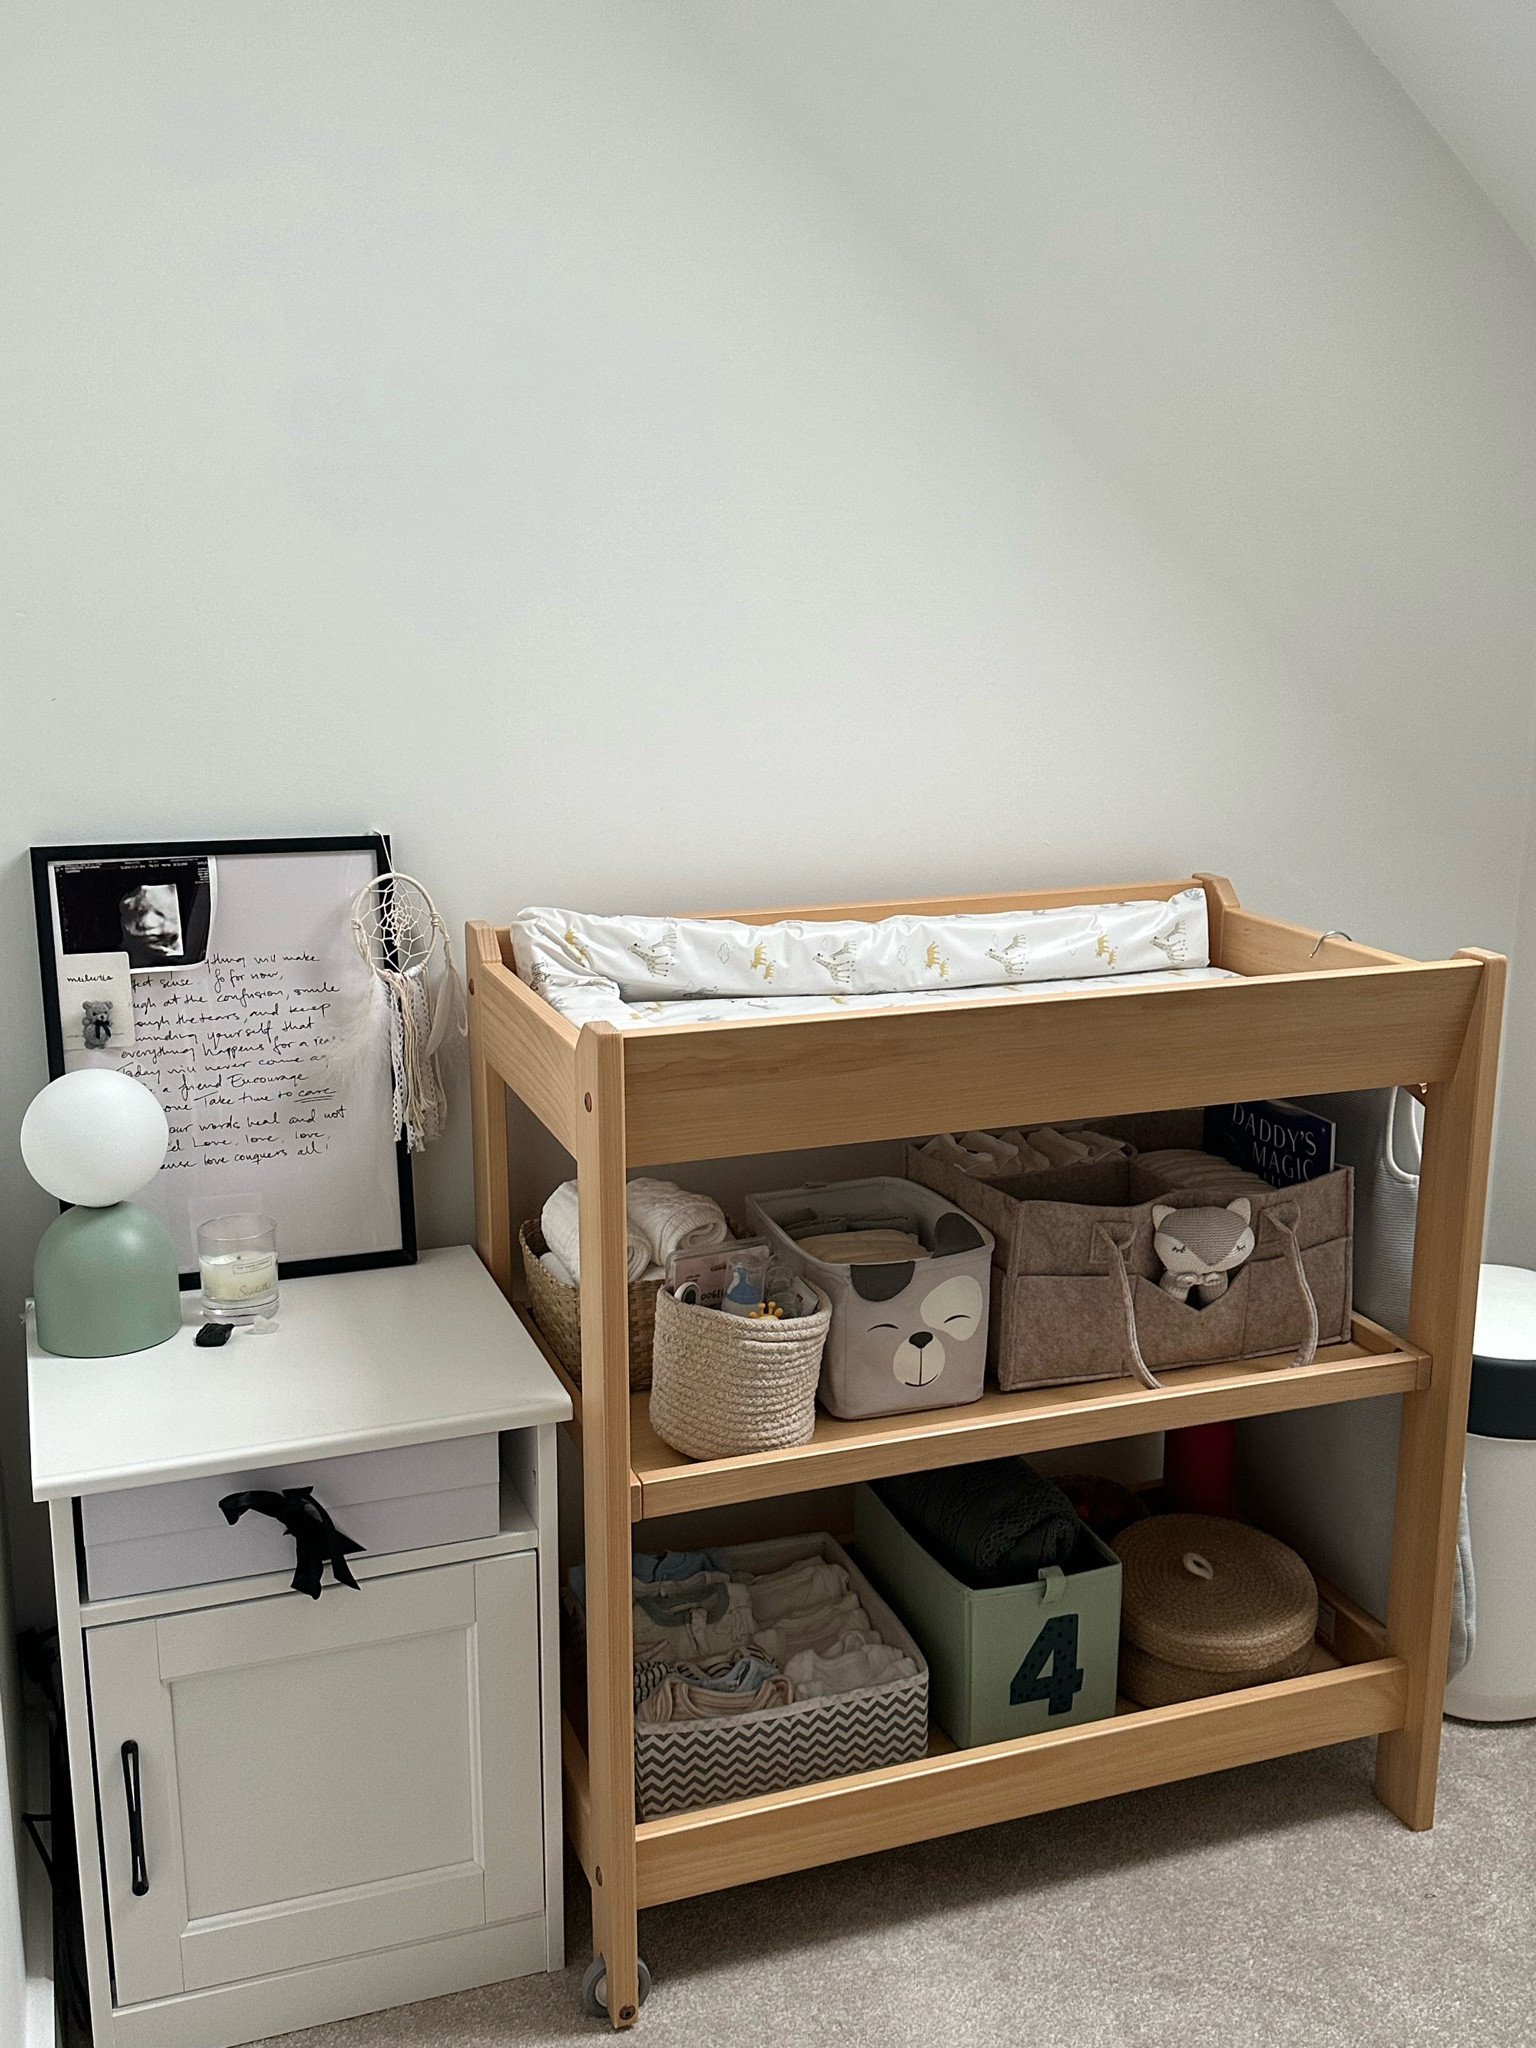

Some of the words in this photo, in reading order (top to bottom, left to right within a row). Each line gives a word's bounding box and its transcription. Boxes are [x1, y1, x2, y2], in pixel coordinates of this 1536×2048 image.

[254, 954, 276, 965] will
[282, 951, 320, 961] make
[131, 975, 154, 993] fect
[230, 969, 245, 988] for
[133, 998, 156, 1015] ugh
[164, 994, 182, 1007] at
[184, 994, 209, 1004] the
[294, 981, 340, 995] smile
[135, 1016, 170, 1030] ough
[176, 1013, 199, 1025] the
[249, 1002, 279, 1017] and
[290, 1003, 331, 1018] keep
[135, 1030, 198, 1044] minding
[282, 1016, 315, 1032] that
[121, 1046, 195, 1064] everything
[202, 1042, 265, 1060] happens
[273, 1036, 297, 1055] for
[205, 1061, 252, 1071] never
[259, 1057, 304, 1066] come
[178, 1074, 222, 1101] friend
[194, 1091, 235, 1107] Take
[238, 1092, 275, 1104] time
[278, 1090, 293, 1099] to
[168, 1124, 194, 1134] our
[199, 1115, 241, 1131] words
[247, 1112, 280, 1128] heal
[289, 1109, 316, 1125] and
[324, 1105, 348, 1119] not
[1231, 1103, 1317, 1157] DADDY'S
[160, 1161, 198, 1170] ause
[204, 1154, 230, 1166] love
[234, 1148, 288, 1165] conquers
[1253, 1141, 1314, 1182] MAGIC
[1009, 1613, 1084, 1717] 4
